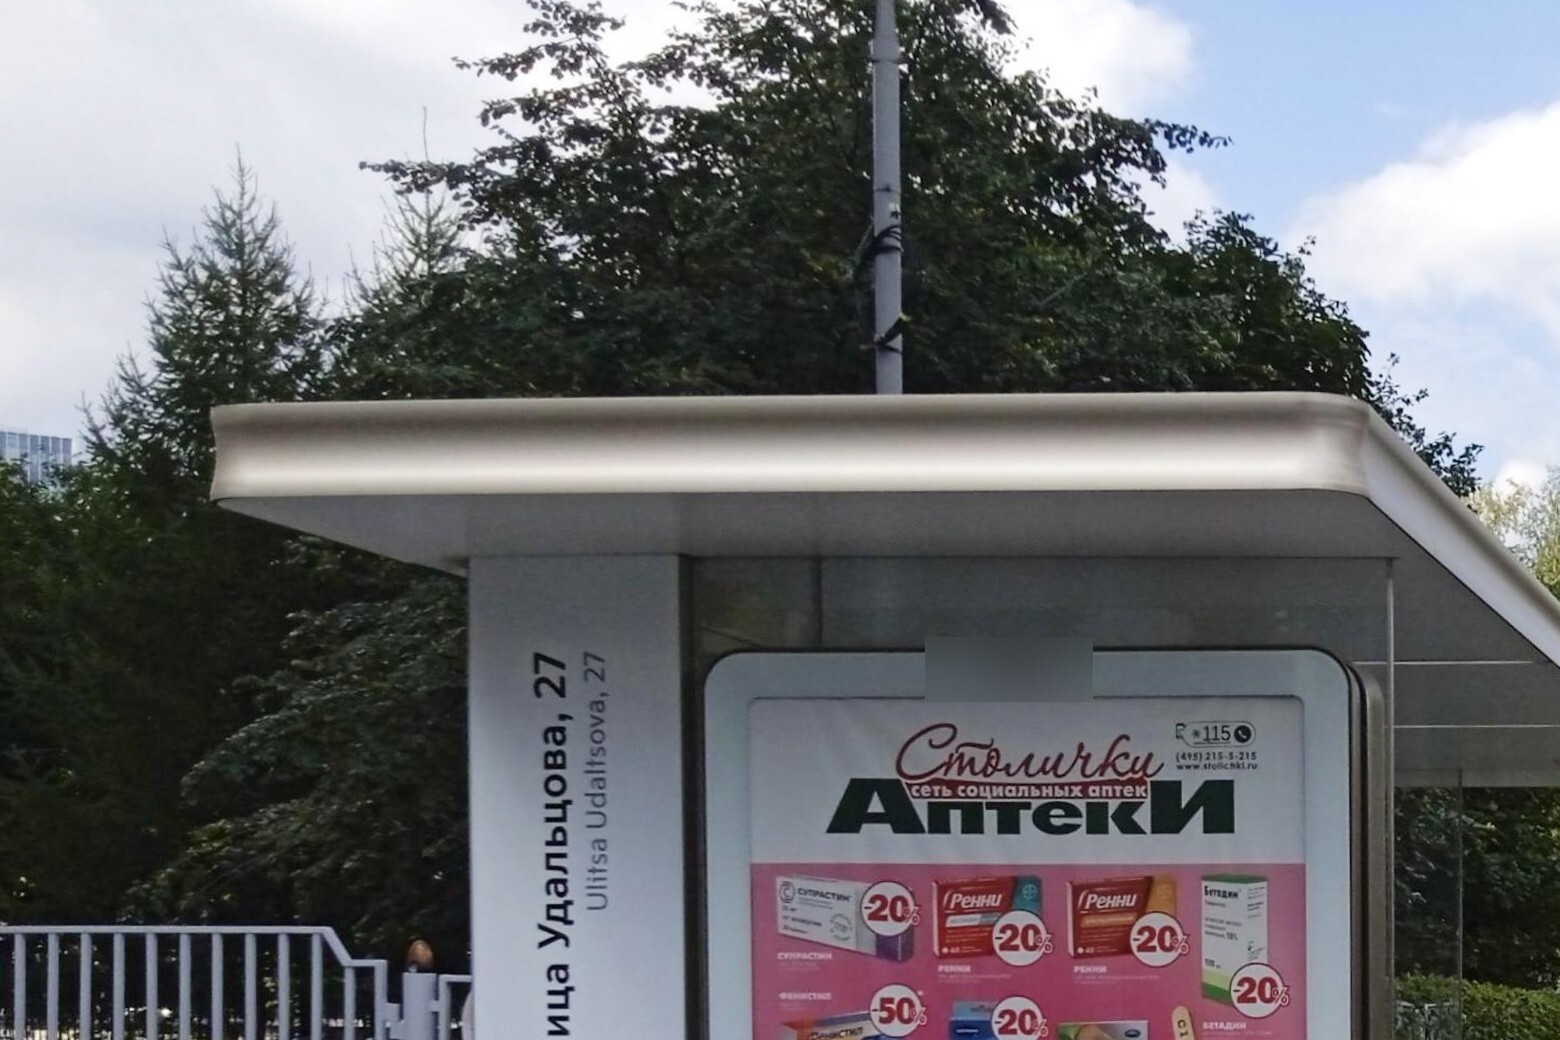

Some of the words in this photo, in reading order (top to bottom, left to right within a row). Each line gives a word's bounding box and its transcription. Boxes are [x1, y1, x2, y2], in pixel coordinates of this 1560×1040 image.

[533, 651, 567, 699] 27
[582, 651, 606, 682] 27
[584, 692, 610, 829] Udaltsova,
[896, 723, 1164, 780] Столички
[1176, 751, 1202, 762] (495)
[911, 784, 952, 798] сеть
[957, 784, 1087, 799] социальных
[1088, 784, 1148, 798] аптек
[537, 714, 574, 949] Удальцова,
[586, 837, 608, 911] Ulitsa
[864, 893, 921, 926] -20%
[949, 892, 1002, 909] Ренни
[1084, 893, 1137, 909] Ренни
[995, 923, 1054, 954] -20%
[1132, 925, 1190, 956] -20%
[1233, 976, 1290, 1007] -20%
[995, 1008, 1049, 1038] -20%
